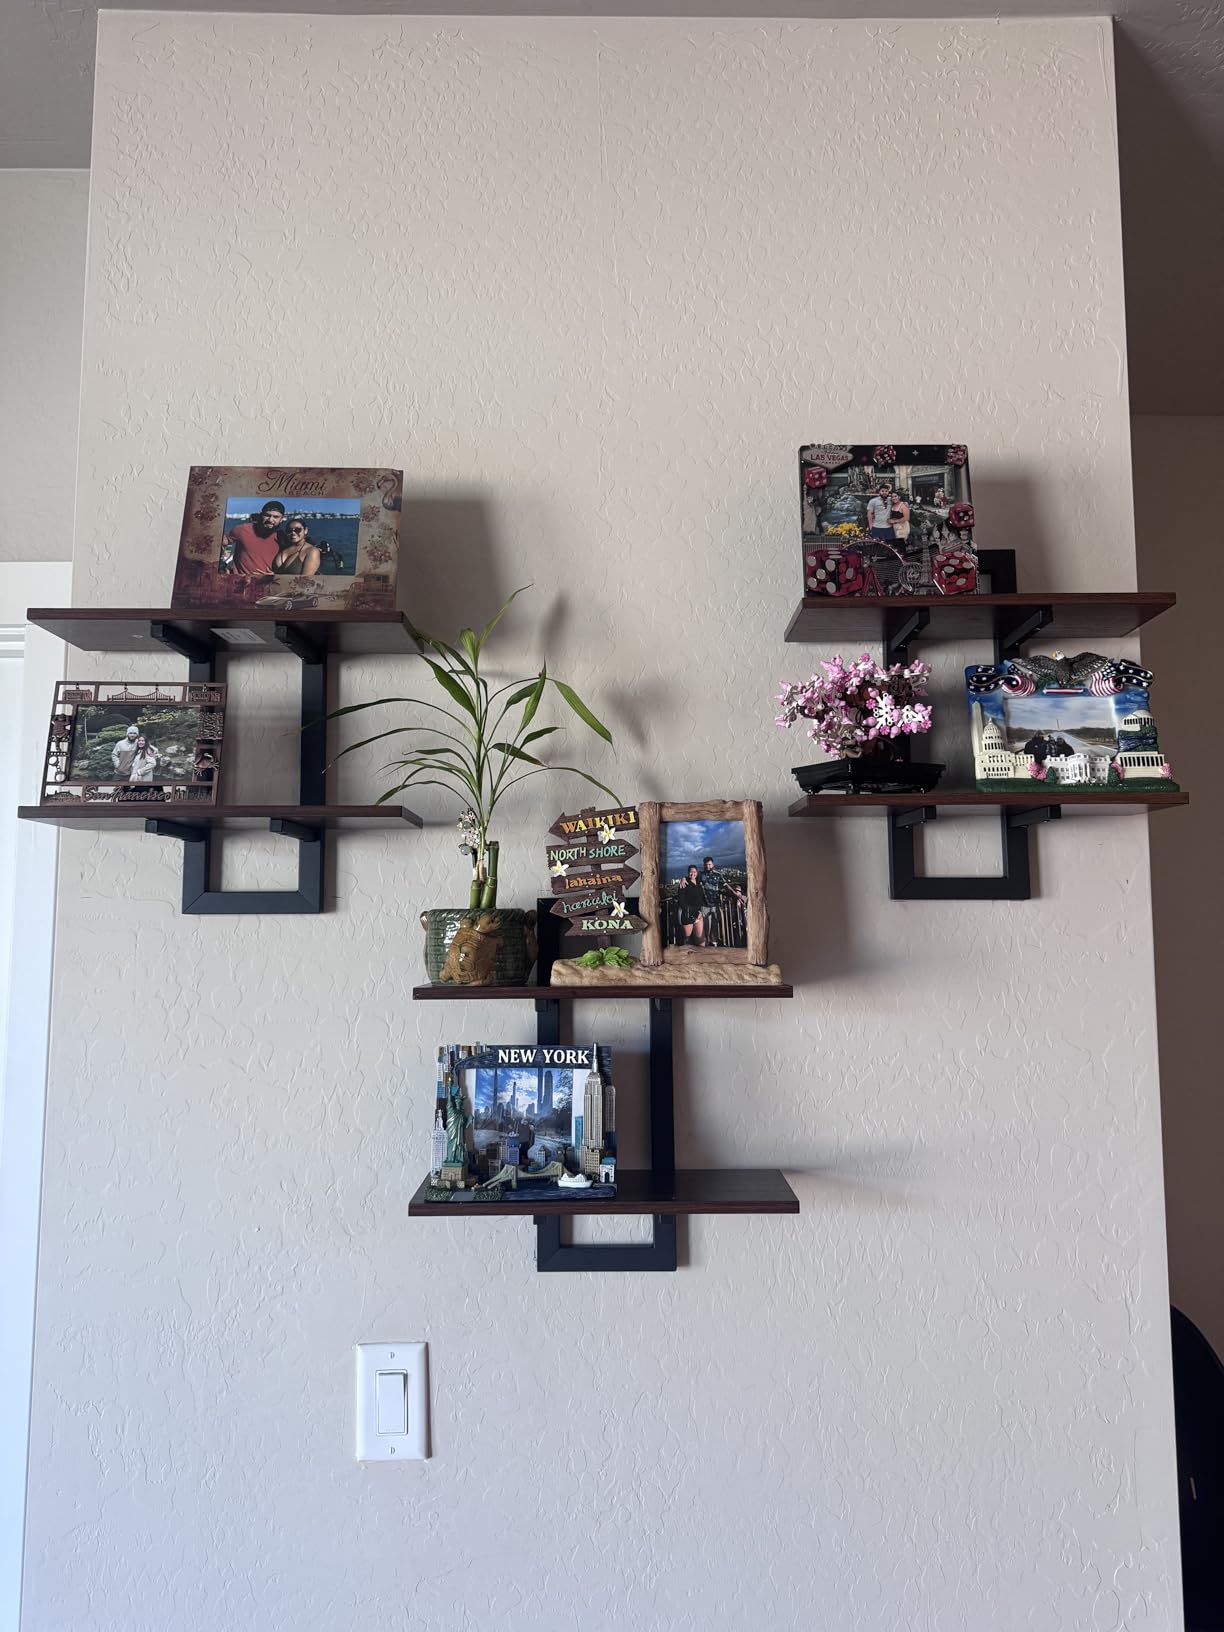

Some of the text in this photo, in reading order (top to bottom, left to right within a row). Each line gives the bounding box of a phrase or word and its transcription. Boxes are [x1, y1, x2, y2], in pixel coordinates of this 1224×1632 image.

[257, 469, 328, 493] Miami
[560, 810, 637, 834] WAIKIKI
[550, 845, 626, 861] NORTH SHORE
[581, 919, 634, 930] KONA
[498, 1049, 590, 1064] NEW YORK
